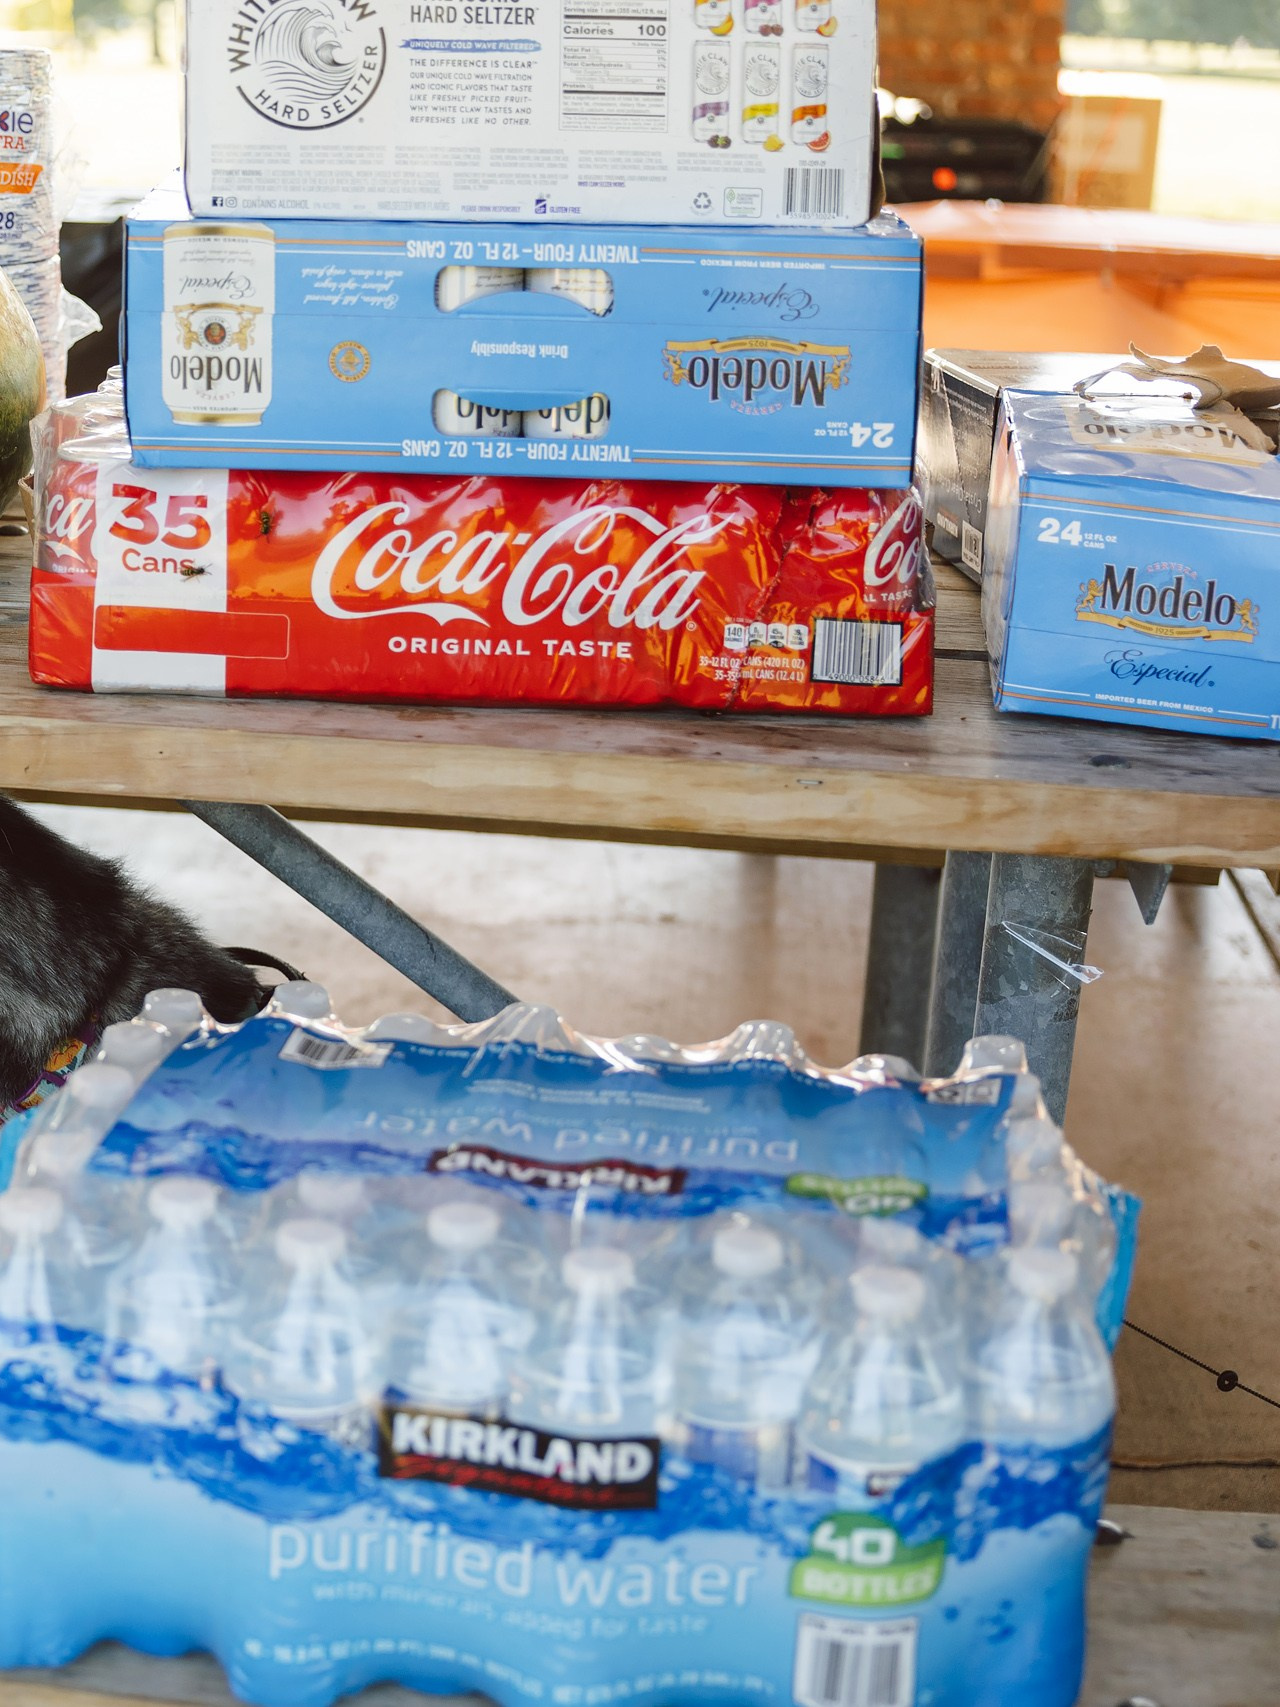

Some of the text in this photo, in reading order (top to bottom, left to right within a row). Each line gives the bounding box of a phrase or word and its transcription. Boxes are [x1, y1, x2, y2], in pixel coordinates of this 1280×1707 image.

[410, 5, 535, 25] HARD SELTZER
[563, 24, 666, 36] Calories 100
[410, 58, 426, 67] THE
[430, 59, 487, 68] DIFFERENCE
[491, 60, 500, 68] IS
[255, 45, 378, 121] HARD SELTZER
[426, 72, 452, 80] UNIQUE
[474, 73, 493, 81] WAVE
[494, 73, 532, 81] FILTRATION
[456, 84, 488, 92] FLAVORS
[471, 95, 500, 103] PICKED
[410, 116, 456, 124] REFRESHES
[431, 105, 457, 113] WHITE
[459, 106, 481, 114] CLAW
[484, 106, 512, 114] TASTES
[242, 200, 277, 209] CONTAINS
[278, 199, 309, 209] ALCOHOL
[406, 240, 640, 264] TWENTY FOUR 12 FL. OZ. CANS
[700, 258, 826, 270] IMPORTED BEER FROM MEXICO
[180, 271, 256, 299] Especial
[707, 282, 820, 321] Especial
[470, 340, 568, 358] Drink Responsibly
[170, 355, 263, 394] Modelo
[688, 356, 827, 407] Modelo
[729, 400, 783, 415] CERVEZA
[826, 421, 848, 429] CANS
[849, 422, 895, 449] 24
[402, 439, 631, 463] TWENTY FOUR 12 FL. OZ. CANS
[109, 483, 212, 550] 35
[1037, 517, 1117, 547] 24 12 FL OZ
[1083, 540, 1105, 549] CANS
[122, 548, 196, 574] Cans
[311, 500, 736, 630] Coca-Cola
[1146, 561, 1198, 580] CERVEZA
[1100, 562, 1237, 626] Modelo
[726, 627, 742, 637] 140
[1154, 627, 1175, 636] 1925
[388, 635, 632, 659] ORIGINAL TASTE
[763, 656, 781, 668] (420
[782, 658, 790, 668] FL
[791, 658, 805, 669] OZ)
[1104, 649, 1212, 688] Especial
[742, 669, 754, 680] mL
[755, 670, 775, 681] CANS
[776, 670, 795, 682] (12.4
[796, 671, 805, 682] L)
[1095, 693, 1214, 713] IMPORTED BEER FROM MEXICO
[360, 1110, 532, 1144] water
[554, 1126, 799, 1164] purified
[392, 1412, 654, 1484] KIRKLAND
[812, 1520, 897, 1566] 40
[268, 1522, 759, 1607] purified water
